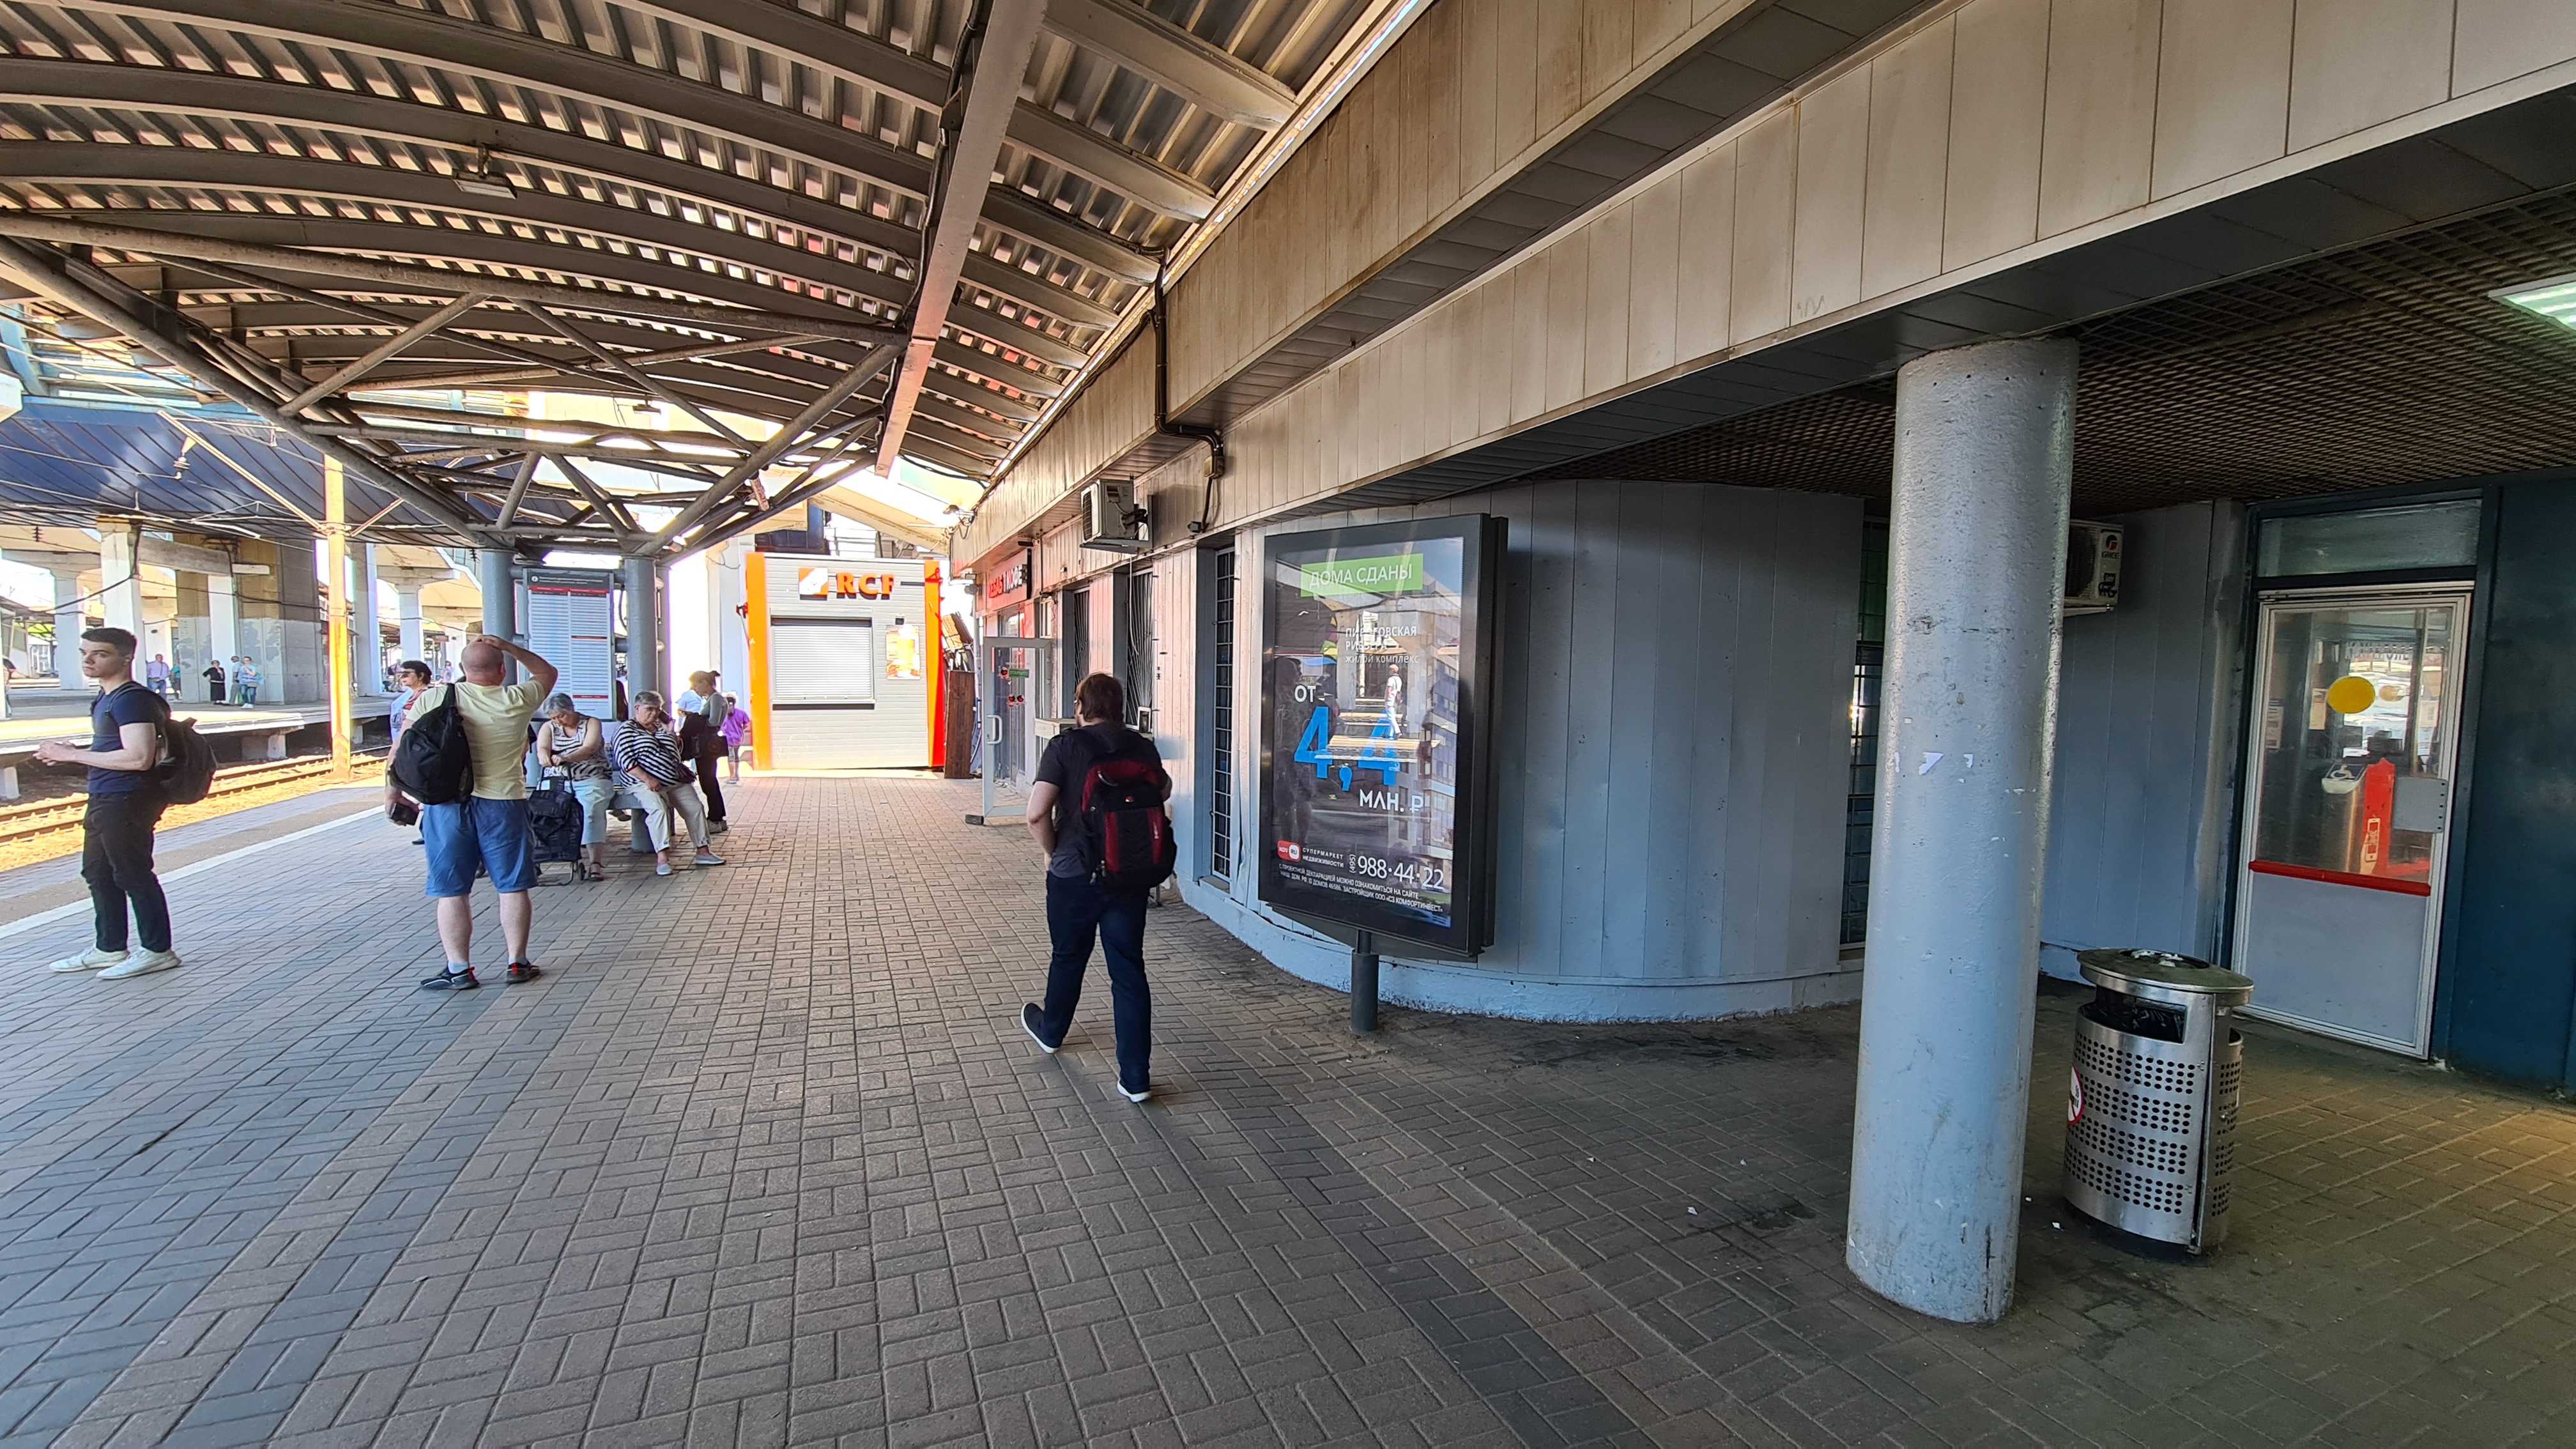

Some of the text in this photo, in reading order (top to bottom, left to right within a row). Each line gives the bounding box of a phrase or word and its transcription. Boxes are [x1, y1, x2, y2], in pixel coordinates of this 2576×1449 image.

[836, 572, 894, 599] RCF
[1310, 564, 1412, 589] ДОМА СДАНЫ
[1345, 625, 1417, 638] ПИРГОВСКАЯ
[1294, 685, 1316, 703] ОТ
[1294, 706, 1401, 792] 4,4
[1303, 848, 1344, 859] СУПЕРМАРКЕТ
[1303, 855, 1344, 868] НЕДВИЖИМОСТИ
[1337, 876, 1354, 885] МОЖНО
[1354, 880, 1393, 894] ОЗНАКОМИТЬСЯ
[1402, 889, 1419, 899] САЙТЕ
[1342, 885, 1374, 899] ЗАСТРОЙЩИК
[1375, 893, 1386, 901] ООО
